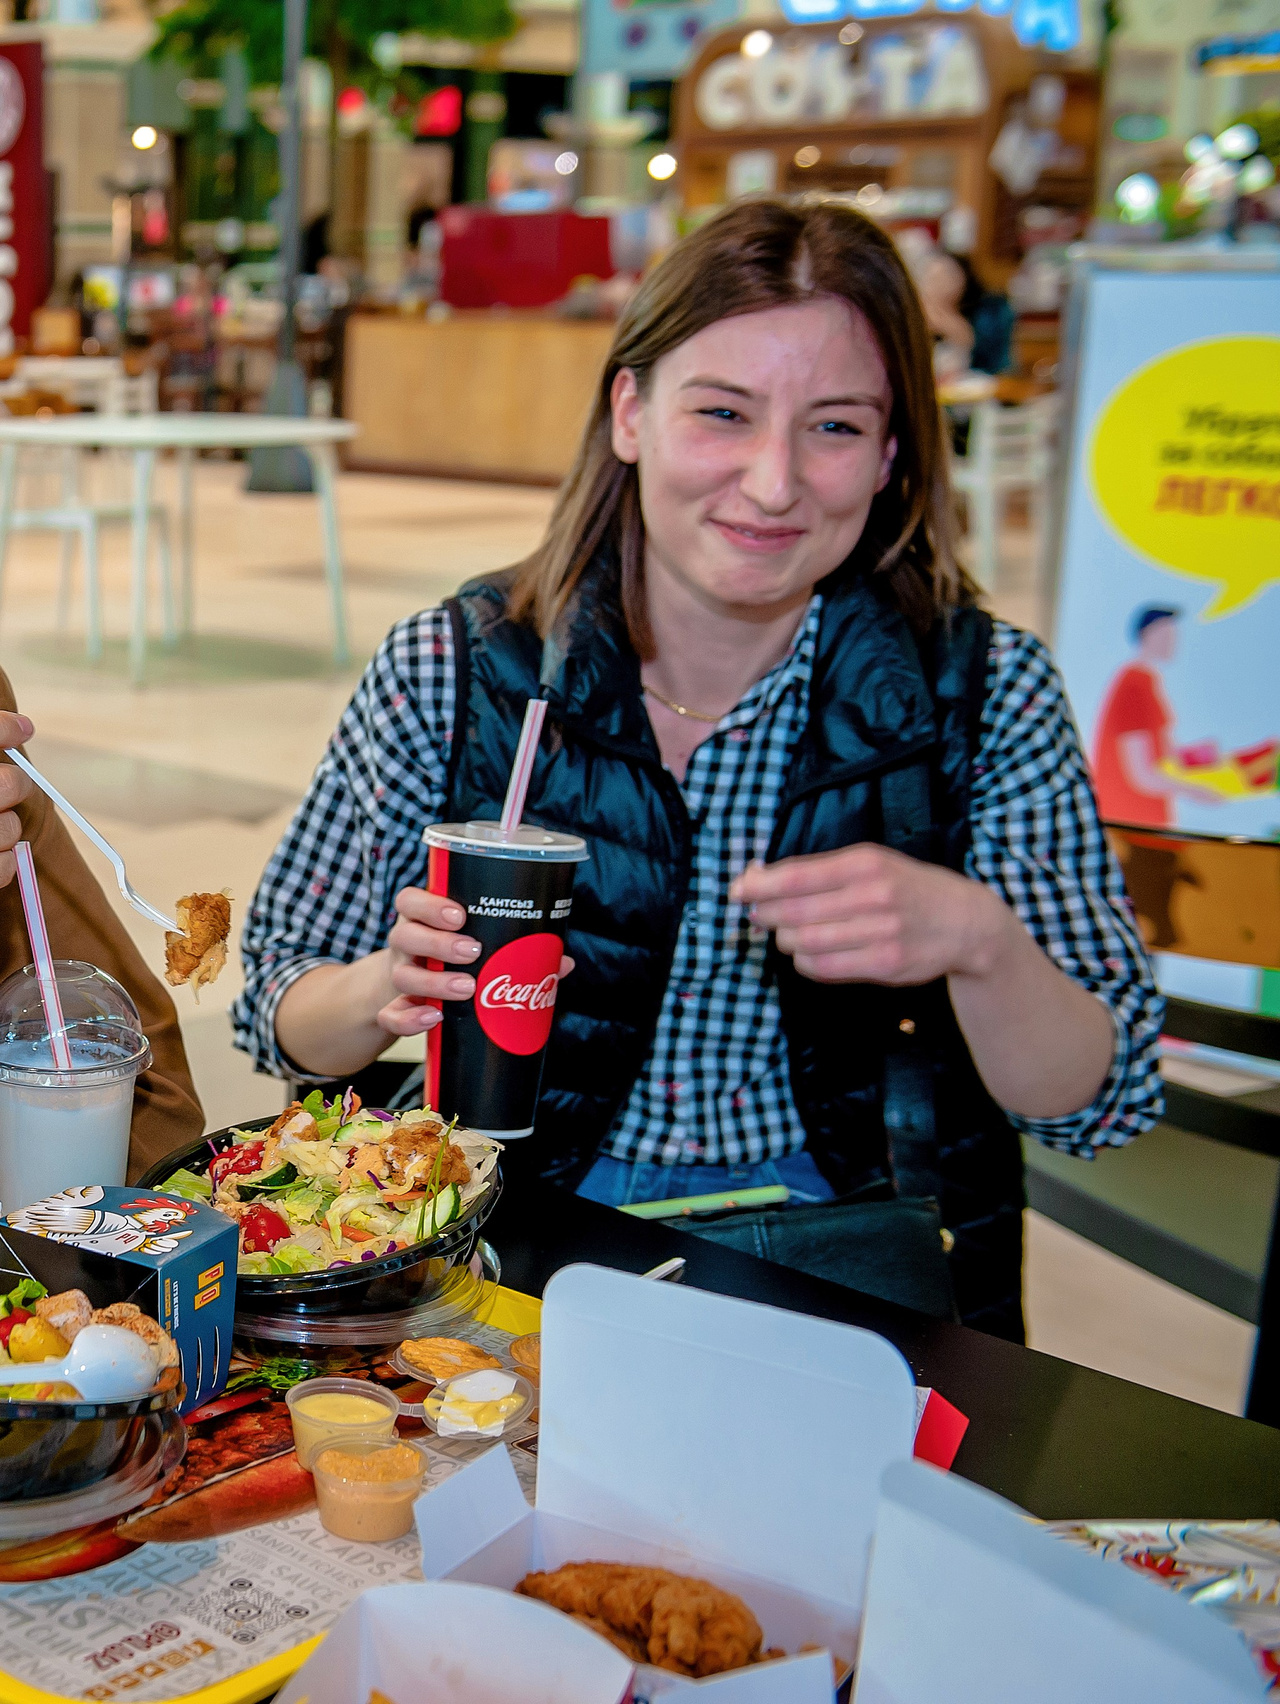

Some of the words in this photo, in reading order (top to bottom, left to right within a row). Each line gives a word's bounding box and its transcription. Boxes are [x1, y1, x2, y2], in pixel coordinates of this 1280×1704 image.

[695, 33, 990, 131] COSTA
[468, 905, 543, 920] КАЛОРИЯСЫЗ
[115, 1232, 138, 1245] PQ
[244, 1528, 366, 1590] SANDWICHES
[270, 1519, 397, 1578] SALADS
[7, 1580, 138, 1640] FAST
